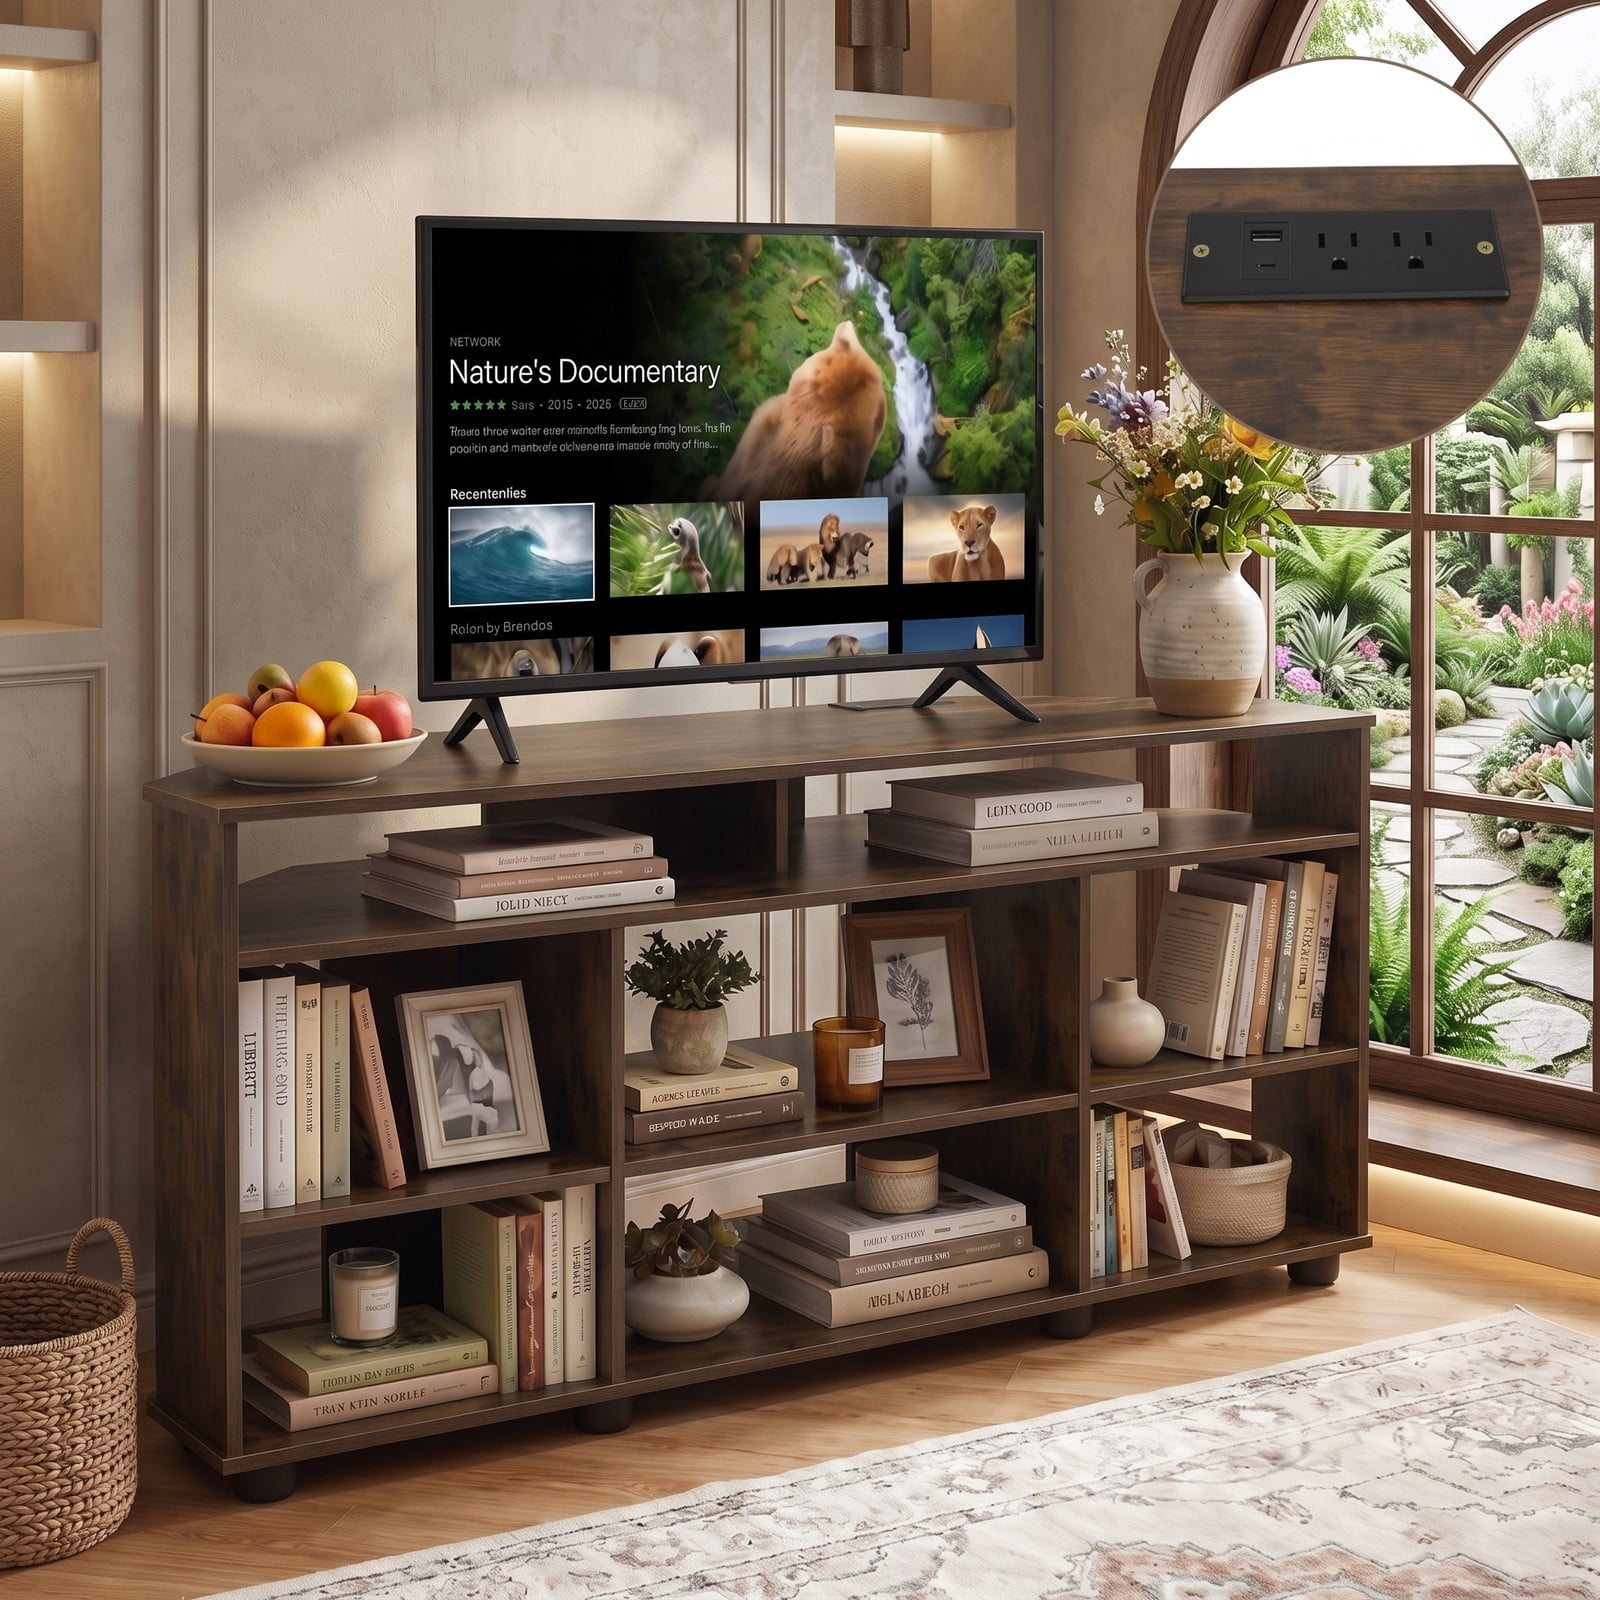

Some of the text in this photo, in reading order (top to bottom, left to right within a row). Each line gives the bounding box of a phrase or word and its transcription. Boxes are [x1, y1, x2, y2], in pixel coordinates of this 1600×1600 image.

[450, 337, 501, 347] NETWORK
[450, 358, 721, 388] Nature's Documentary
[511, 400, 535, 410] Sars
[547, 399, 573, 410] 2015
[489, 442, 509, 453] and
[681, 439, 692, 449] of
[450, 487, 527, 500] Recentenlies
[486, 622, 501, 637] by
[503, 620, 553, 633] Brendos
[689, 1114, 721, 1126] WADE
